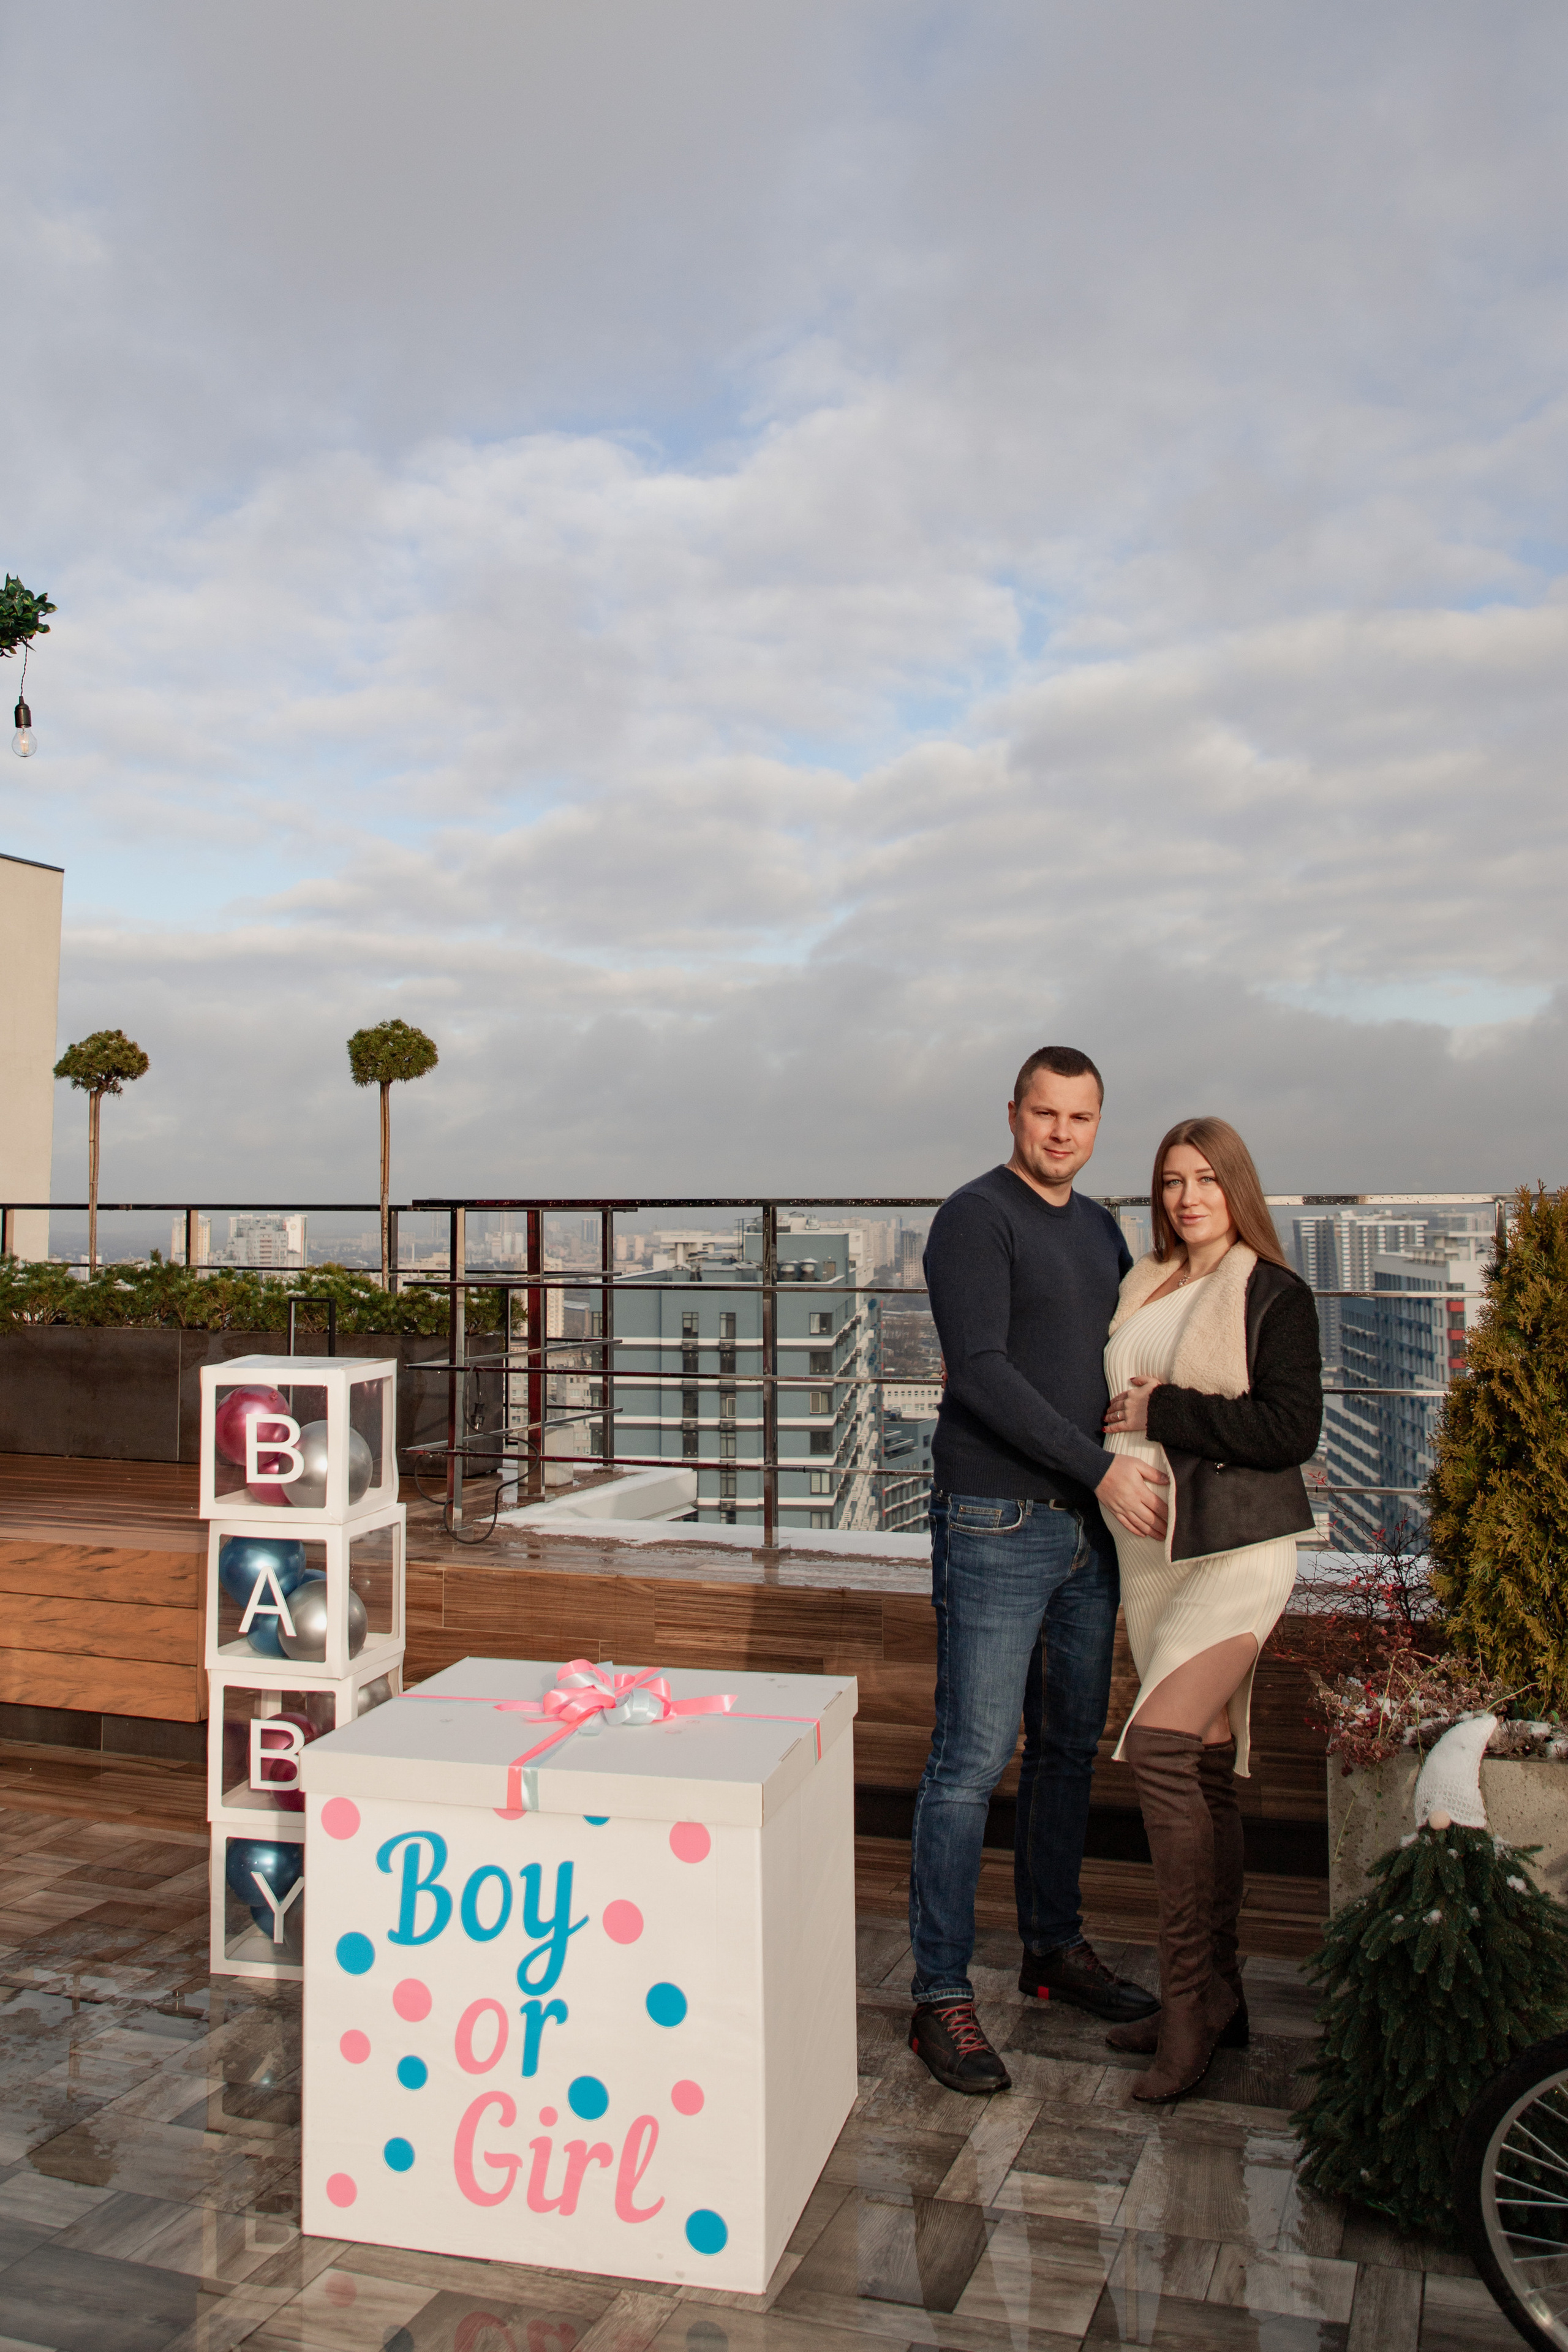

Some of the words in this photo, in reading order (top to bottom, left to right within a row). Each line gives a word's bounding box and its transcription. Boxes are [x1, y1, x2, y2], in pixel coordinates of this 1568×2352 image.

[375, 1830, 590, 1997] Boy
[454, 1997, 569, 2078] or
[453, 2090, 665, 2224] Girl
